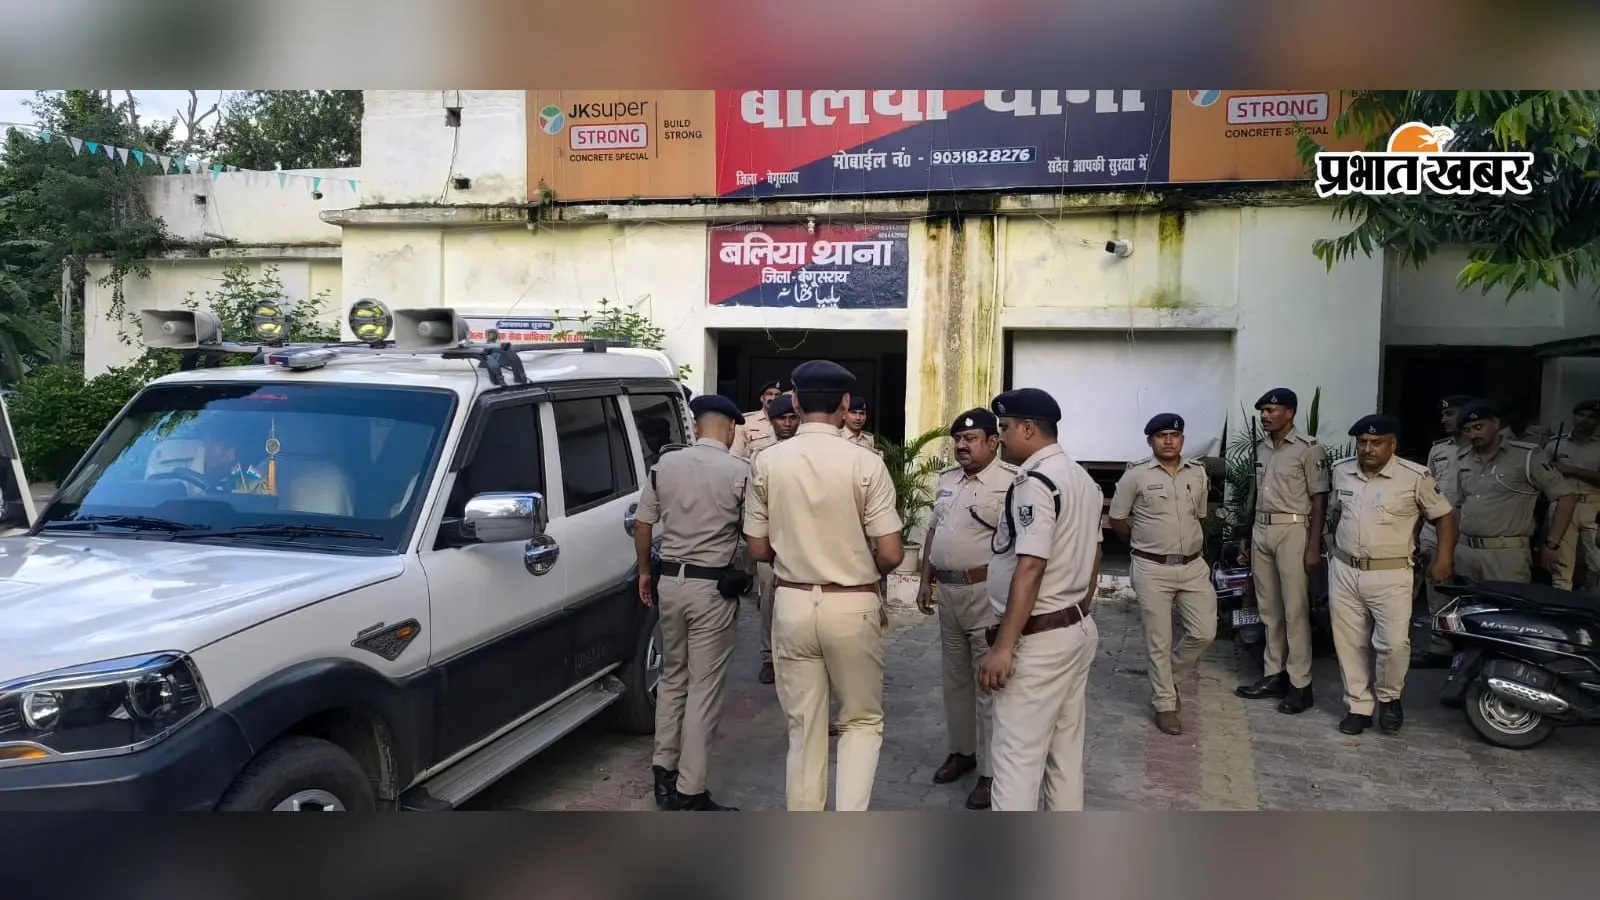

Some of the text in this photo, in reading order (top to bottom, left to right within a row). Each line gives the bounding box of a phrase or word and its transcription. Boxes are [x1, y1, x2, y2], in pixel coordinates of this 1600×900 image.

[1236, 99, 1319, 119] STRONG
[663, 119, 691, 128] BUILD
[577, 128, 640, 145] STRONG
[664, 130, 703, 140] STRONG
[1224, 128, 1283, 139] CONCRETE
[569, 152, 649, 162] CONCRETE SPECIAL
[832, 148, 887, 172] मोबाईल
[932, 148, 1030, 164] 9031828276
[1072, 155, 1106, 173] आपकी
[1108, 157, 1136, 176] सुरक्षा
[1138, 154, 1149, 171] में
[736, 170, 758, 186] जिला
[719, 231, 894, 266] बलिया थाना
[761, 267, 792, 284] जिला
